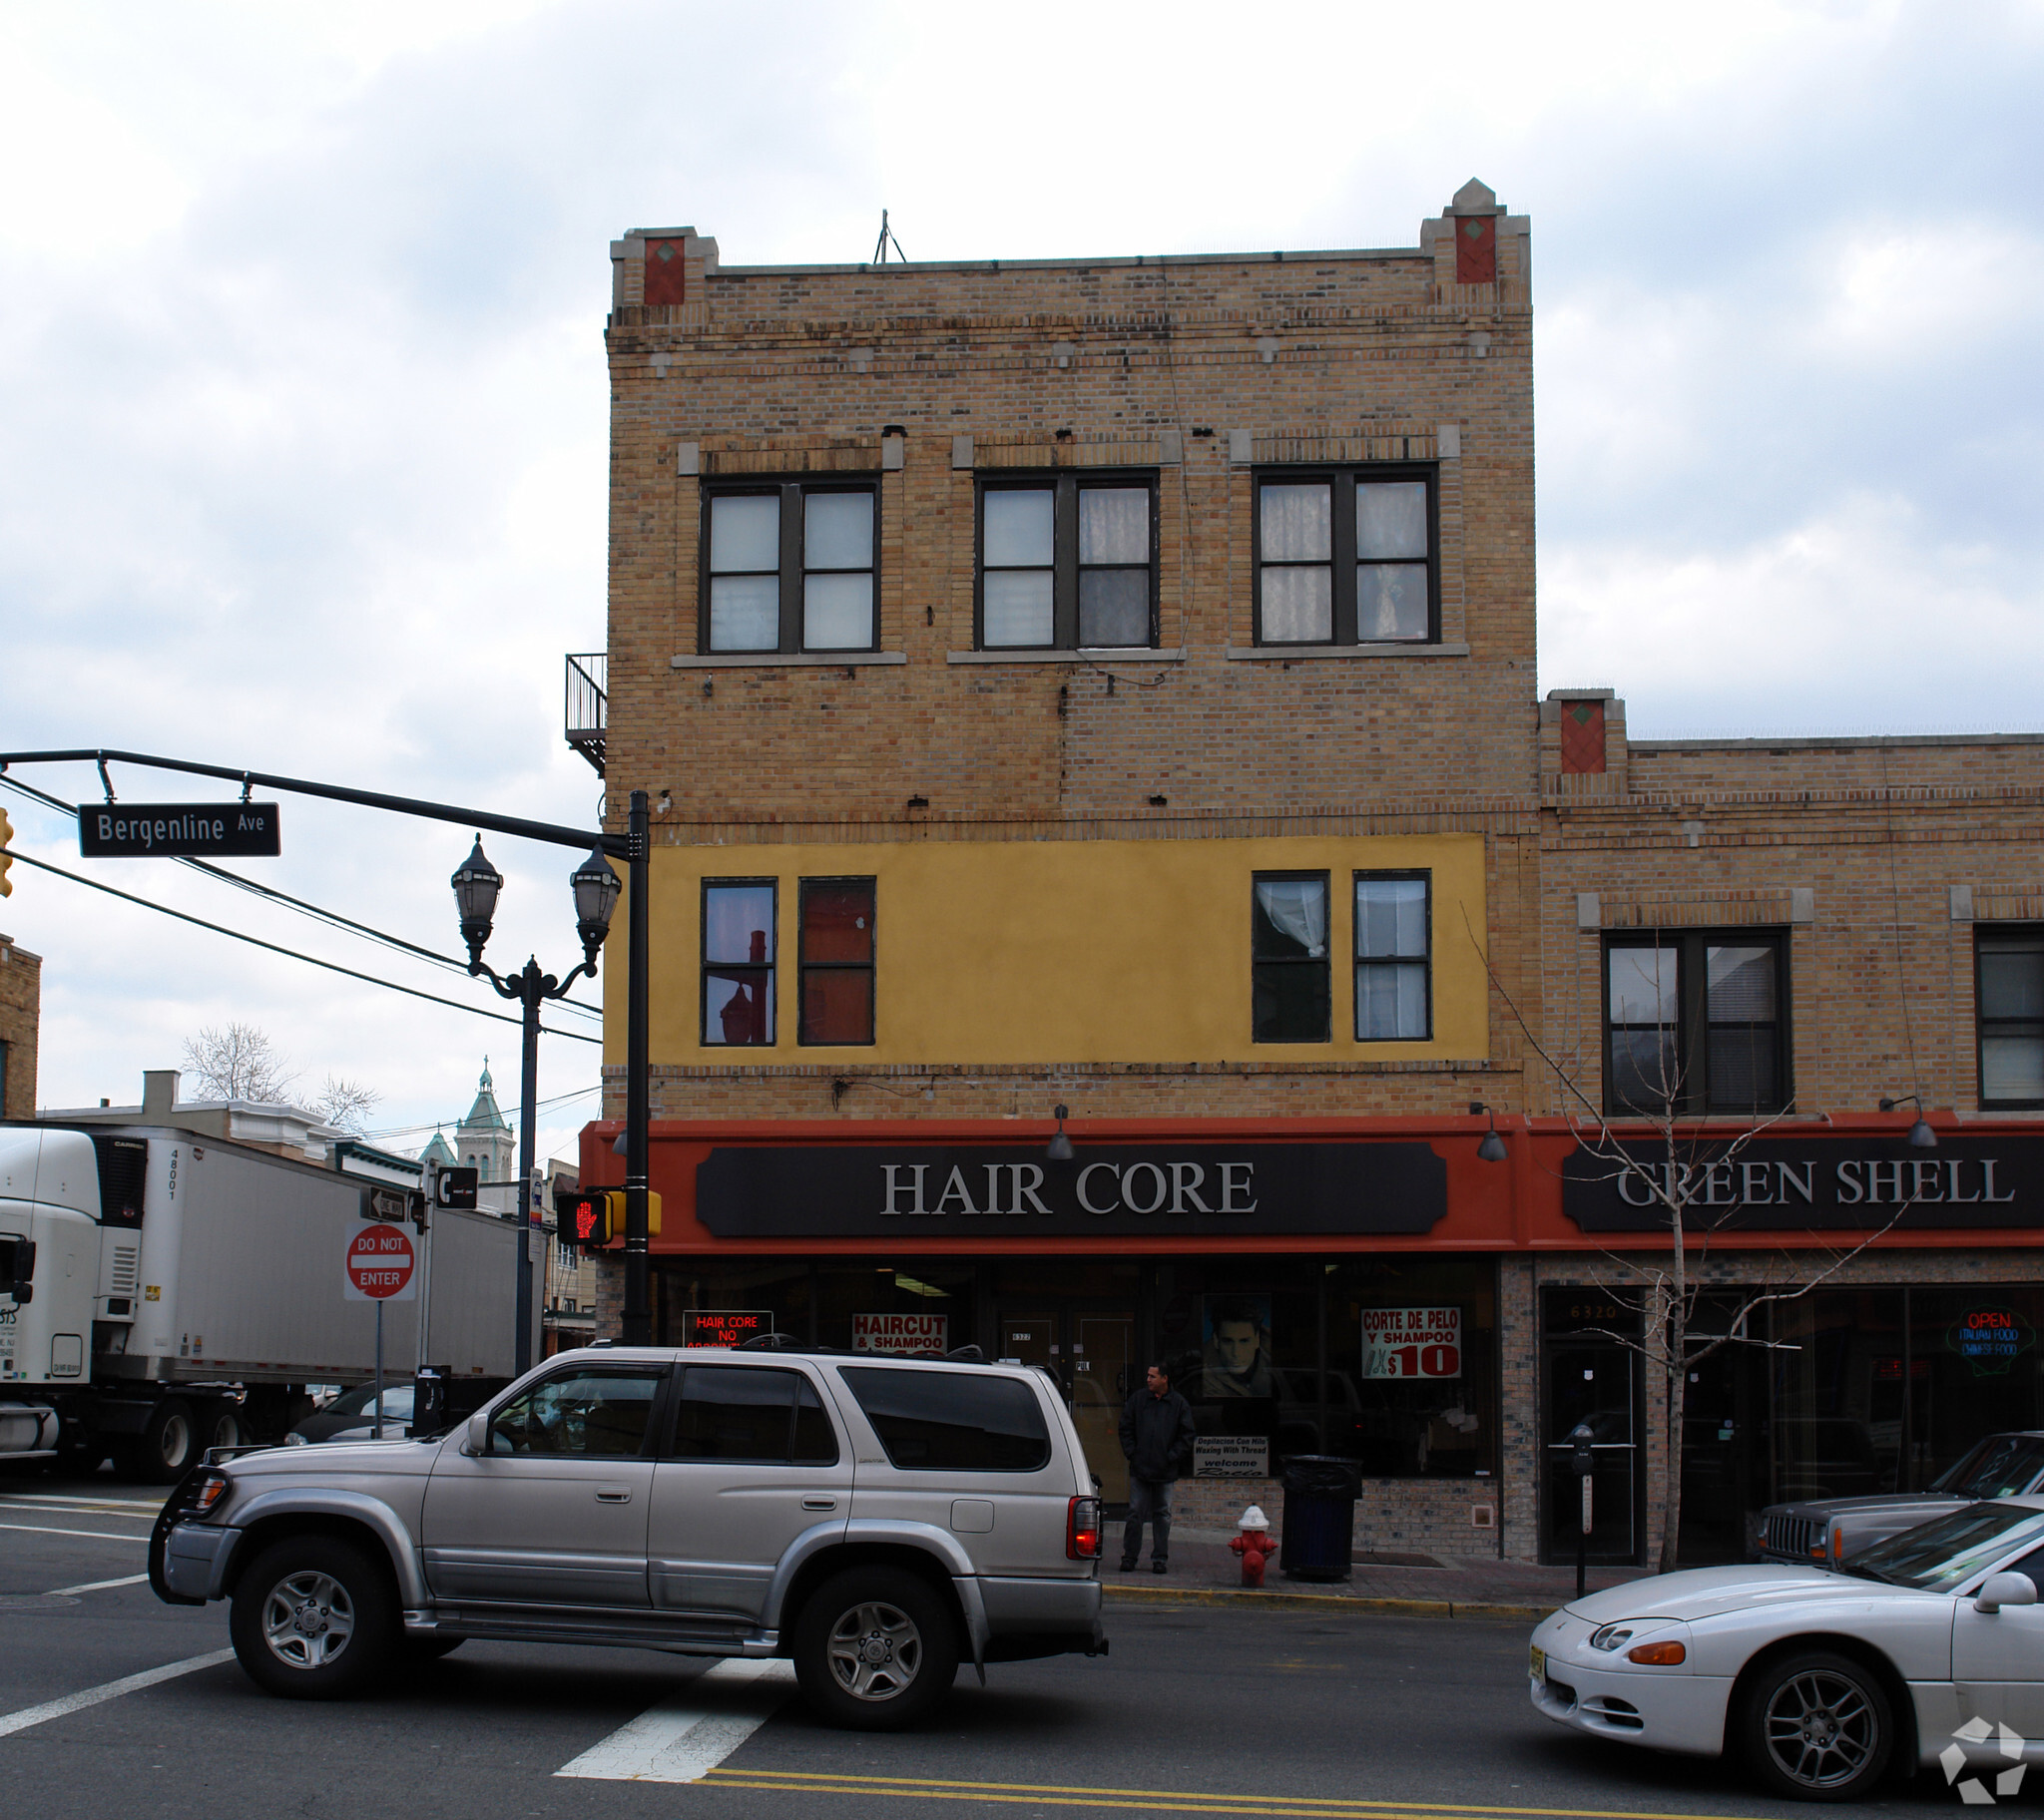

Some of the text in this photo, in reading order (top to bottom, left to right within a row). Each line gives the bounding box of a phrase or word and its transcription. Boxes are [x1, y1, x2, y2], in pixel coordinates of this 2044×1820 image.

[98, 813, 264, 848] Bergenline Ave
[169, 1148, 179, 1200] 48001
[879, 1161, 1258, 1215] HAIR CORE
[1617, 1158, 2016, 1206] GREEN SHELL
[358, 1237, 404, 1251] DO NOT
[360, 1272, 400, 1285] ENTER
[1571, 1305, 1617, 1318] 6320
[697, 1316, 758, 1328] HAIR CORE
[854, 1316, 946, 1335] HAIRCUT
[1363, 1309, 1458, 1331] CORTE DE PELO
[1968, 1312, 2011, 1329] OPEN
[719, 1329, 737, 1341] NO
[1367, 1331, 1454, 1344] Y SHAMPOO
[1958, 1328, 2019, 1341] ITALIAN FOOD
[857, 1336, 943, 1349] & SHAMPOO
[1962, 1343, 2017, 1356] CHINESE FOOD
[1388, 1344, 1459, 1376] $10
